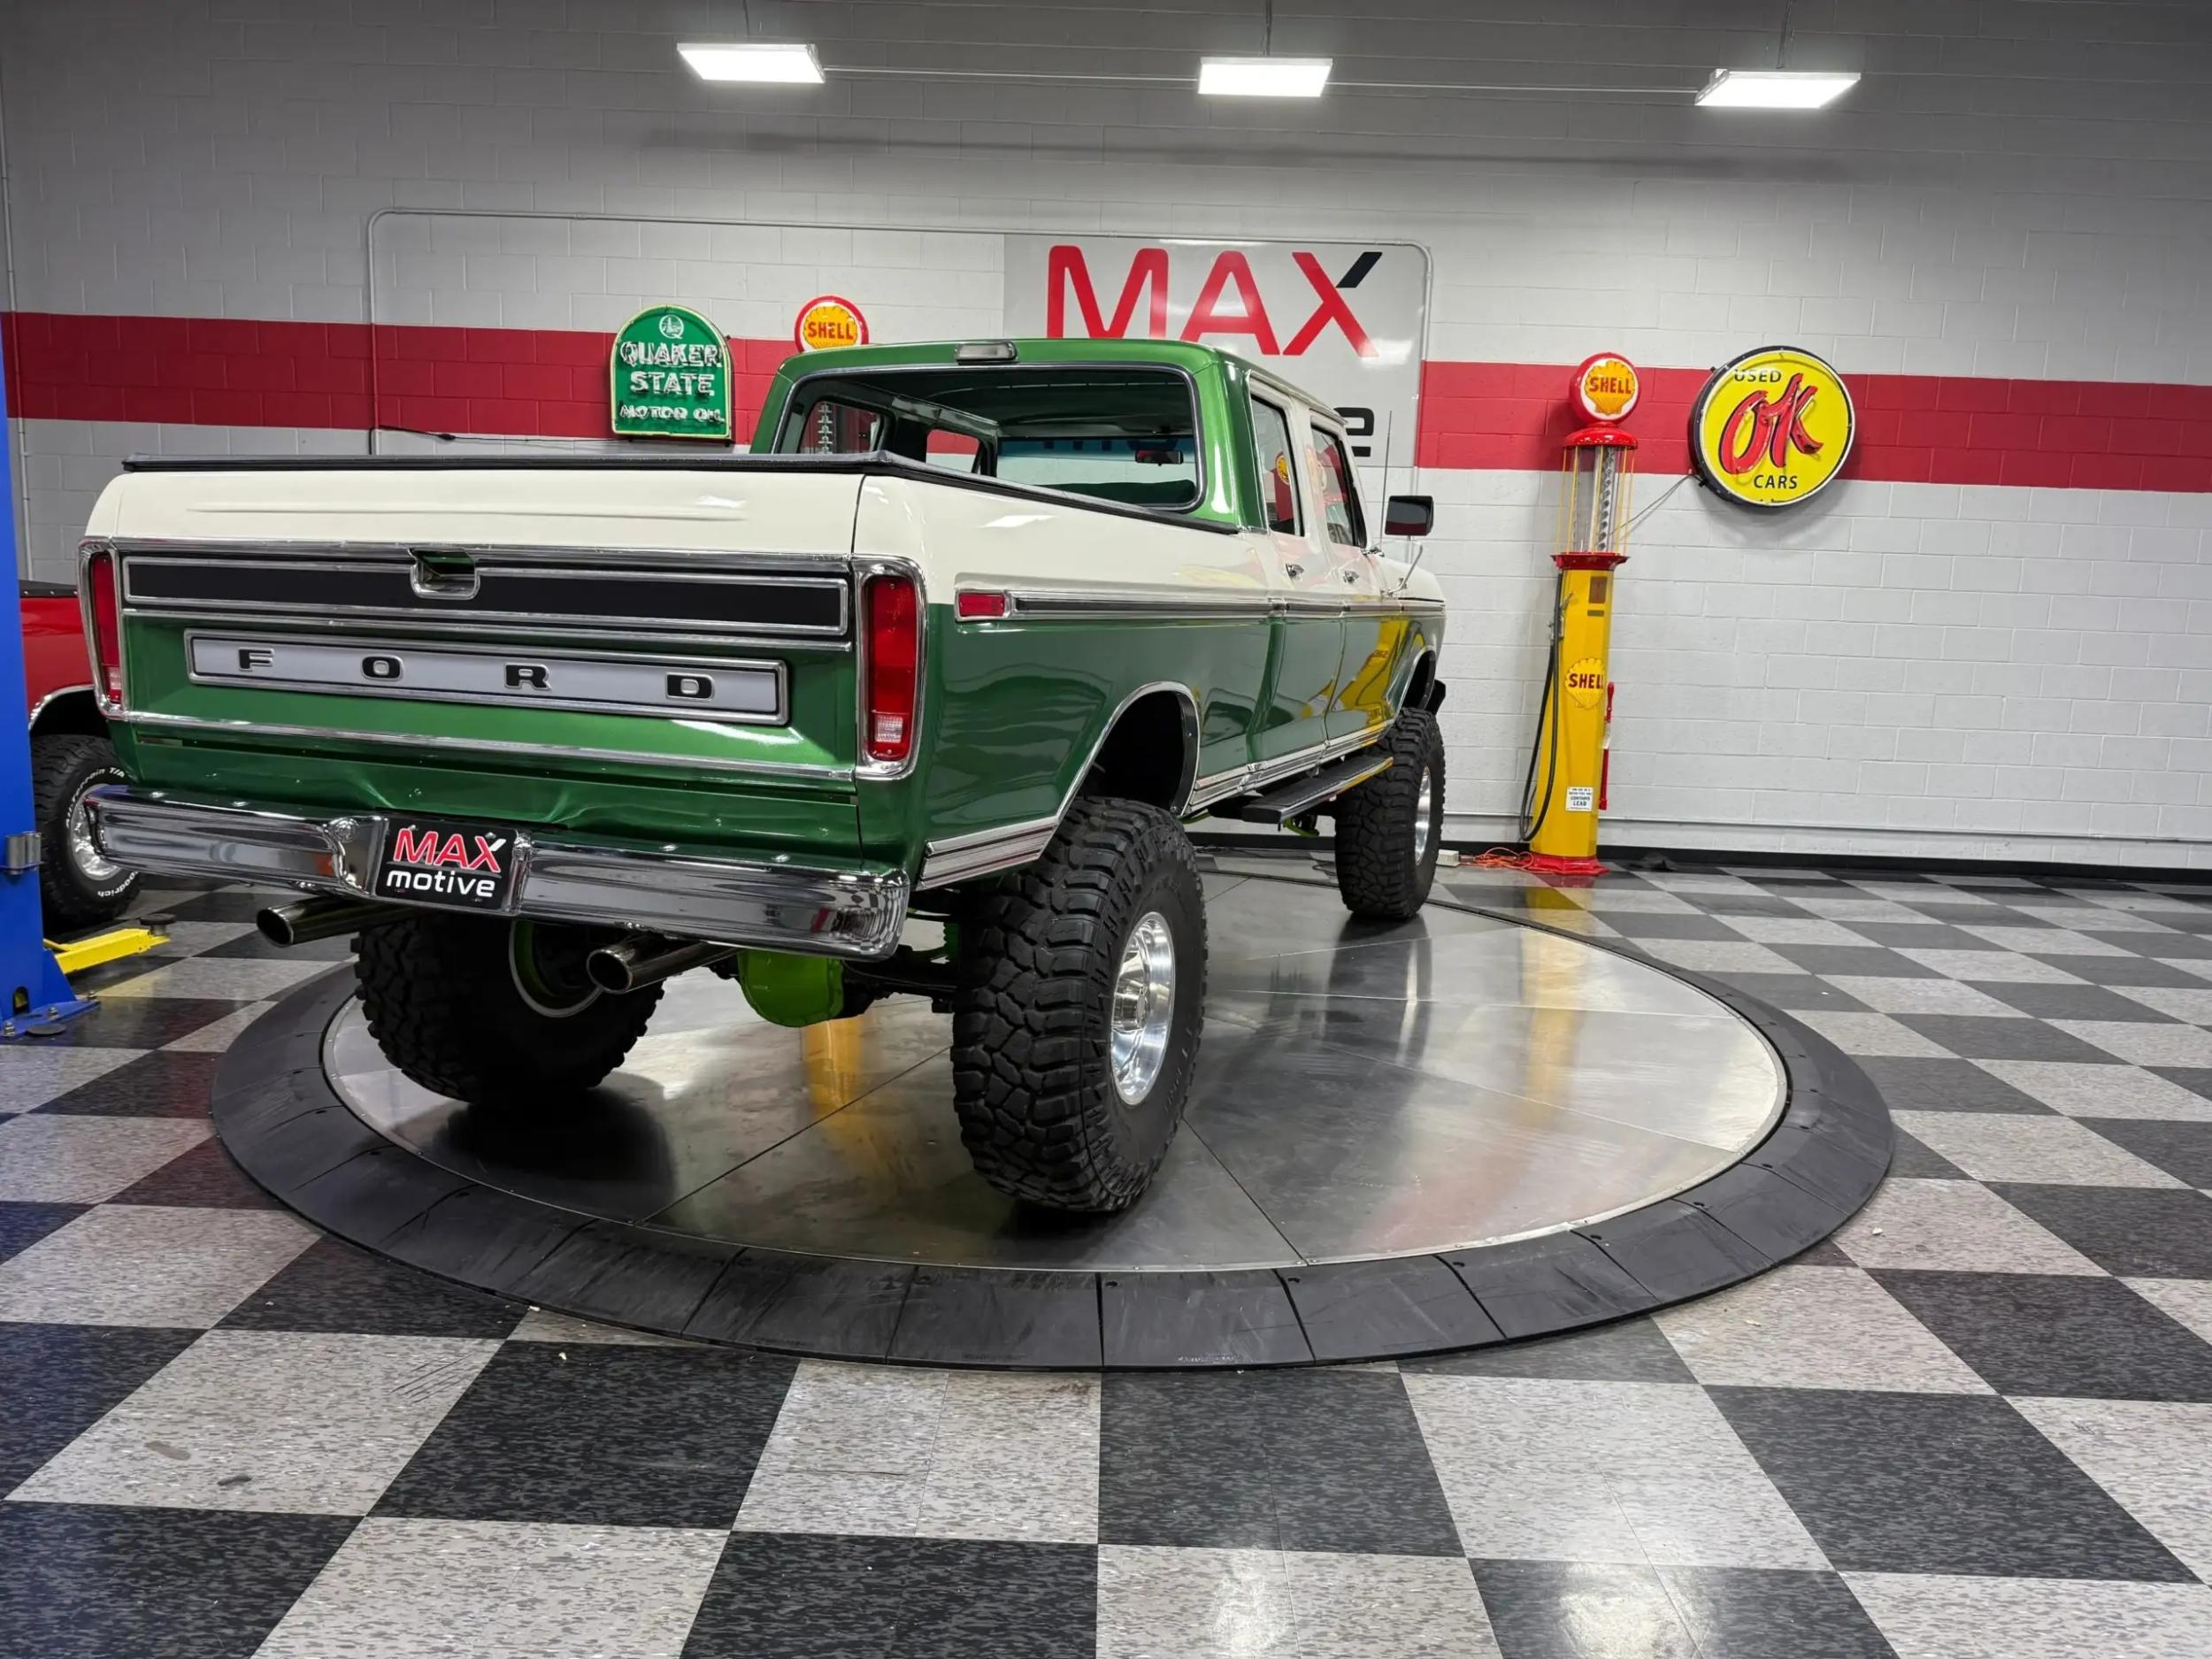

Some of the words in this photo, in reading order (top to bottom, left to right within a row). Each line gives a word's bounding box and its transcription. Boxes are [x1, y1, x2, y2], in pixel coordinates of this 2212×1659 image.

[1047, 244, 1383, 357] MAX
[807, 320, 854, 340] SHELL
[620, 341, 722, 367] QUAKER
[630, 371, 715, 396] STATE
[1588, 377, 1632, 395] SHELL
[1734, 369, 1782, 383] USED
[619, 404, 688, 420] MOTOR
[1719, 373, 1824, 474] OK
[1754, 474, 1799, 490] CARS
[238, 647, 715, 702] FORD
[393, 828, 507, 873] MAX
[97, 871, 139, 897] oodrich
[387, 870, 495, 897] motive
